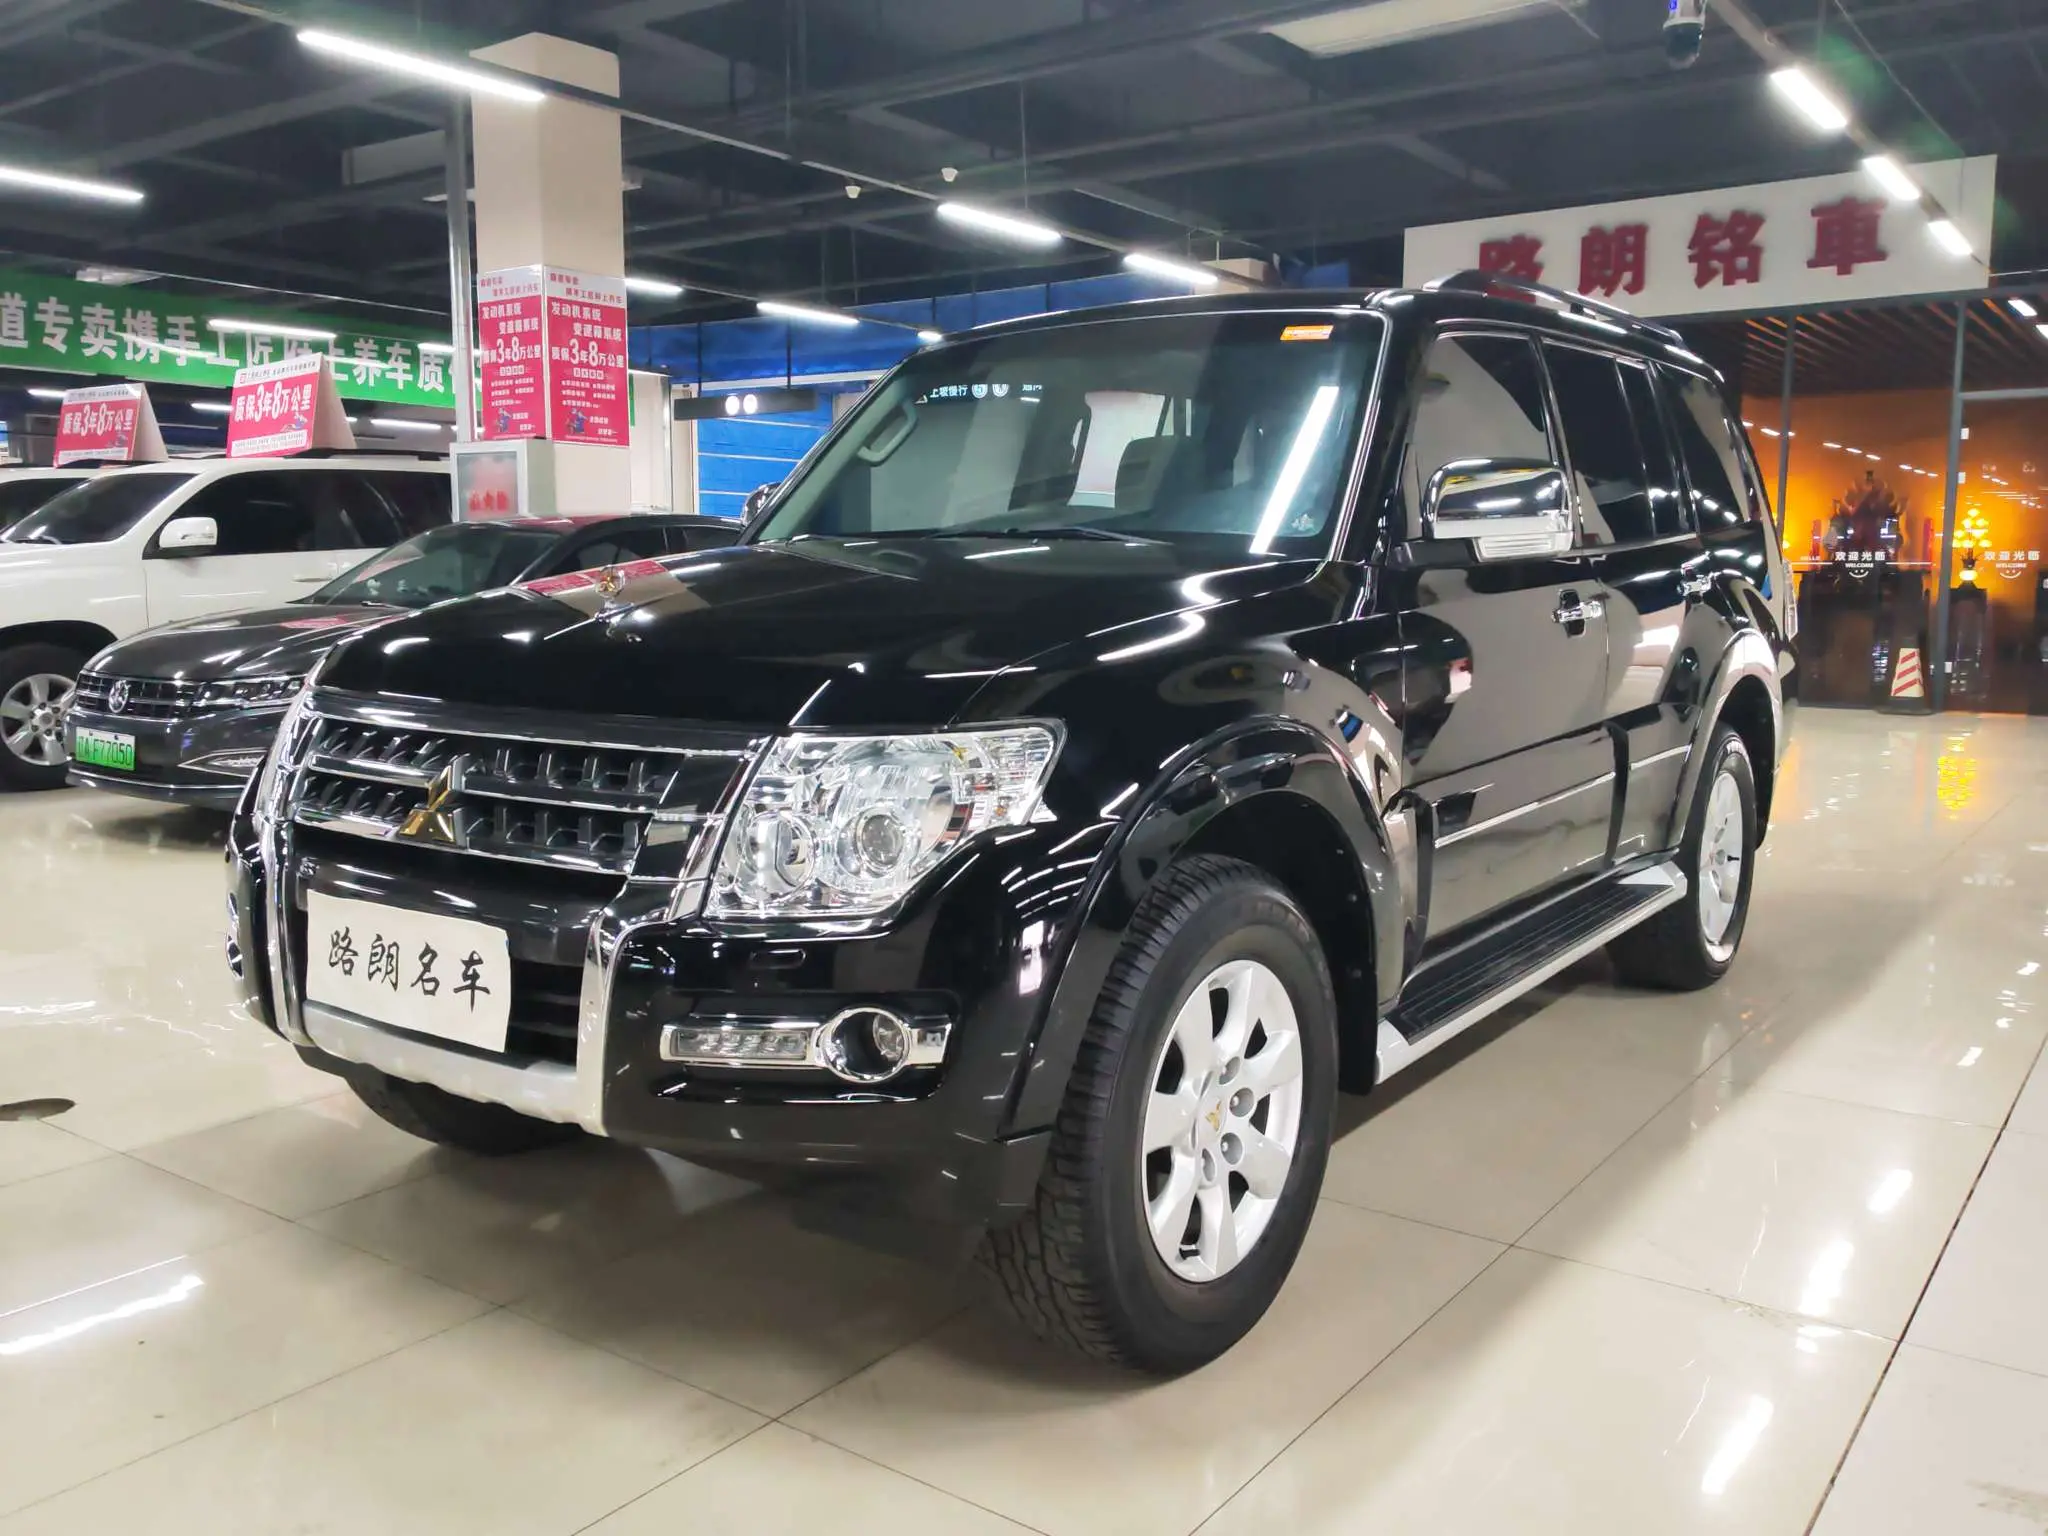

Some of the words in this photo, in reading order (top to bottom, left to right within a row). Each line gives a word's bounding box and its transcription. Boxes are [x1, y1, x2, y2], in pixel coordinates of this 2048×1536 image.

[1477, 198, 1889, 304] 路朗铭車
[551, 301, 602, 322] 发动机系统
[573, 322, 623, 342] 变速箱系统
[551, 338, 625, 368] 质保3年8万公里
[234, 381, 312, 422] 质保3年8万公里
[62, 403, 134, 437] 质保3年8万公里
[1835, 551, 1886, 561] 欢迎光临
[327, 926, 491, 1013] 路朗名车
